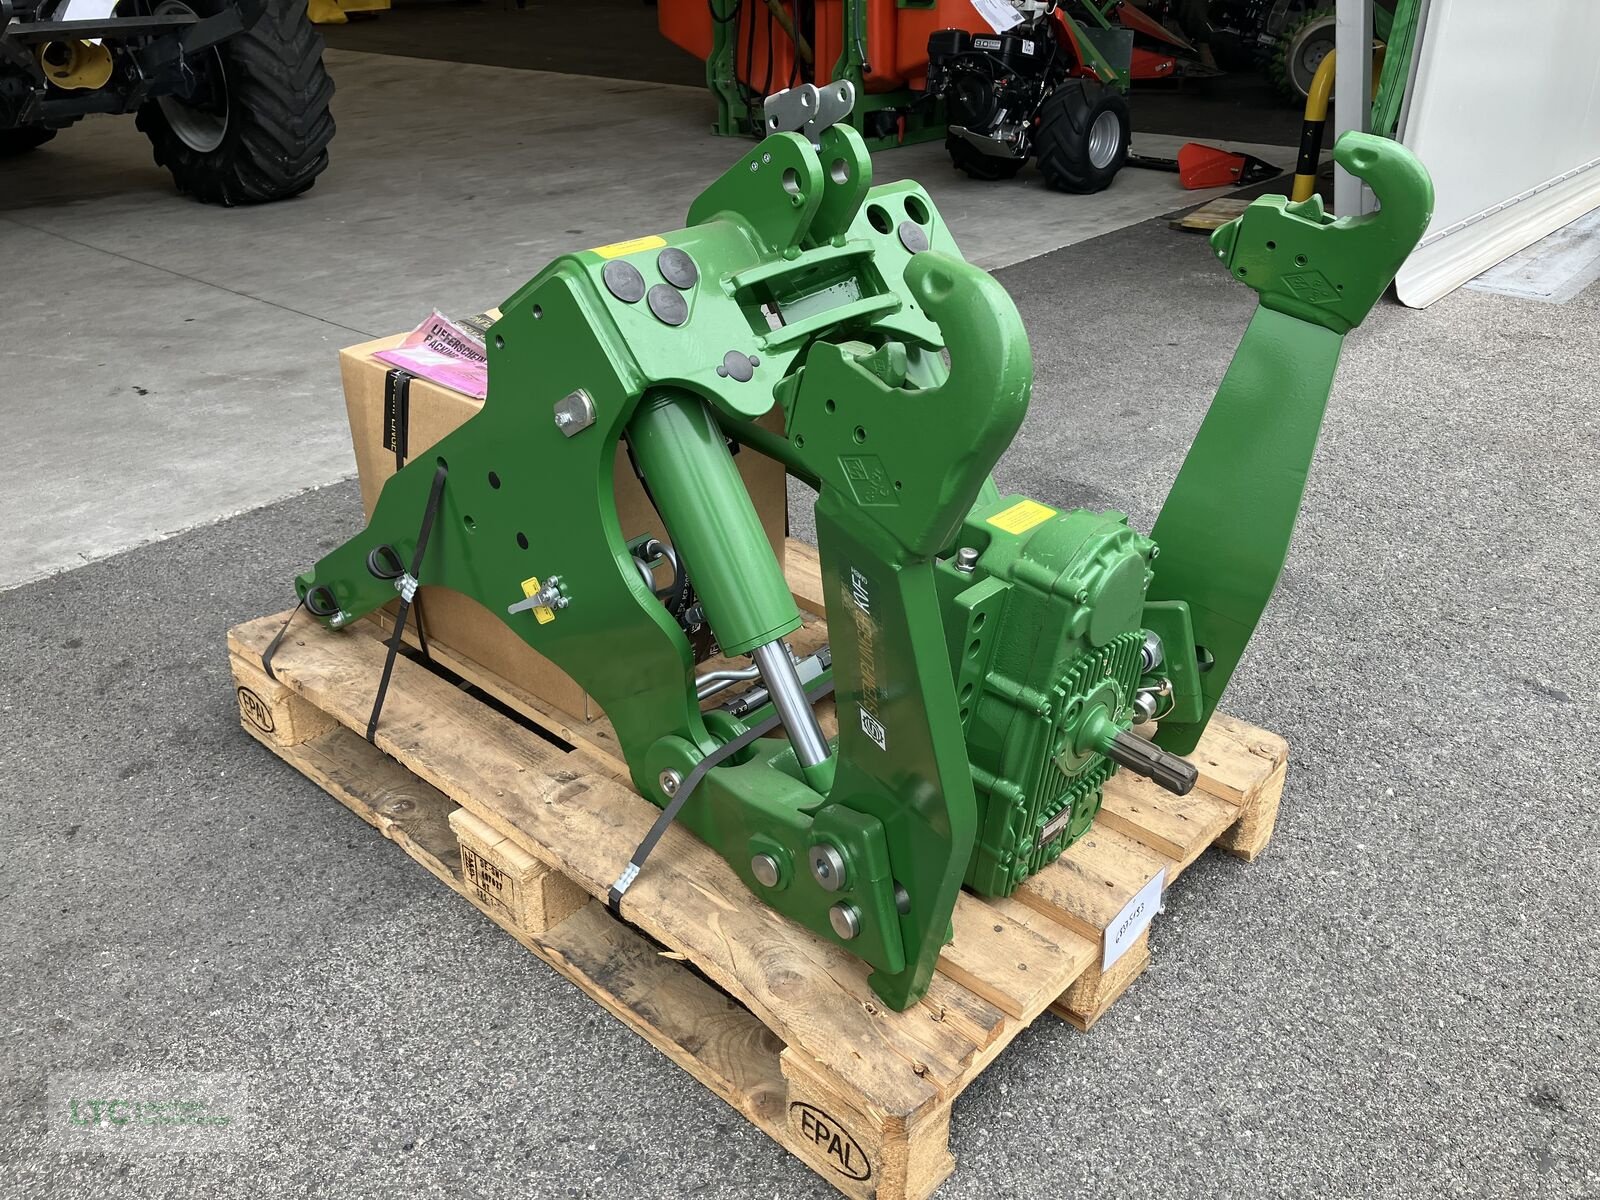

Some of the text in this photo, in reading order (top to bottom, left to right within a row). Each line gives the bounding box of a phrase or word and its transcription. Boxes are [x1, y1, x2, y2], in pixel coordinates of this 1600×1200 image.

[851, 574, 870, 615] KVF
[242, 691, 271, 729] EPAL
[802, 1108, 858, 1175] EPAL
